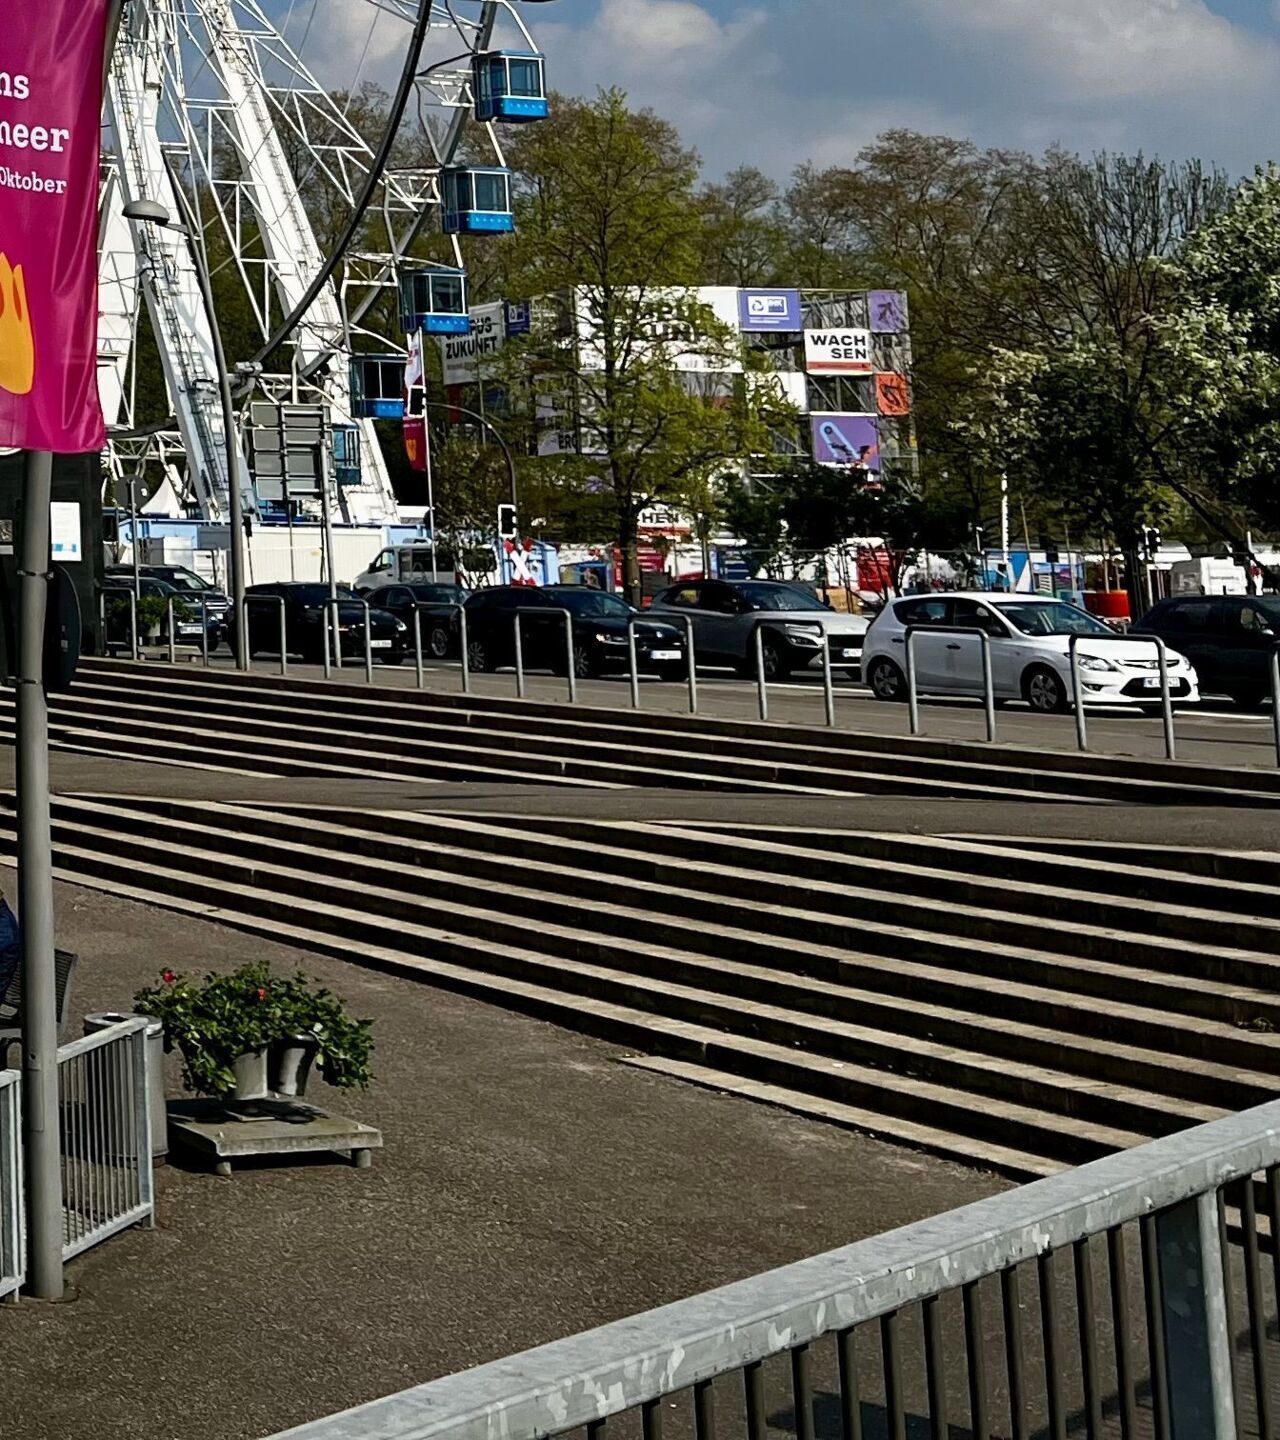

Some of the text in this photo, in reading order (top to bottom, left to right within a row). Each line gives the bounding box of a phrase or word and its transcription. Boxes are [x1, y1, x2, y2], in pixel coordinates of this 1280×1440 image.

[810, 334, 867, 346] WACH
[445, 335, 498, 360] ZUKUNFT
[830, 347, 867, 359] SEN
